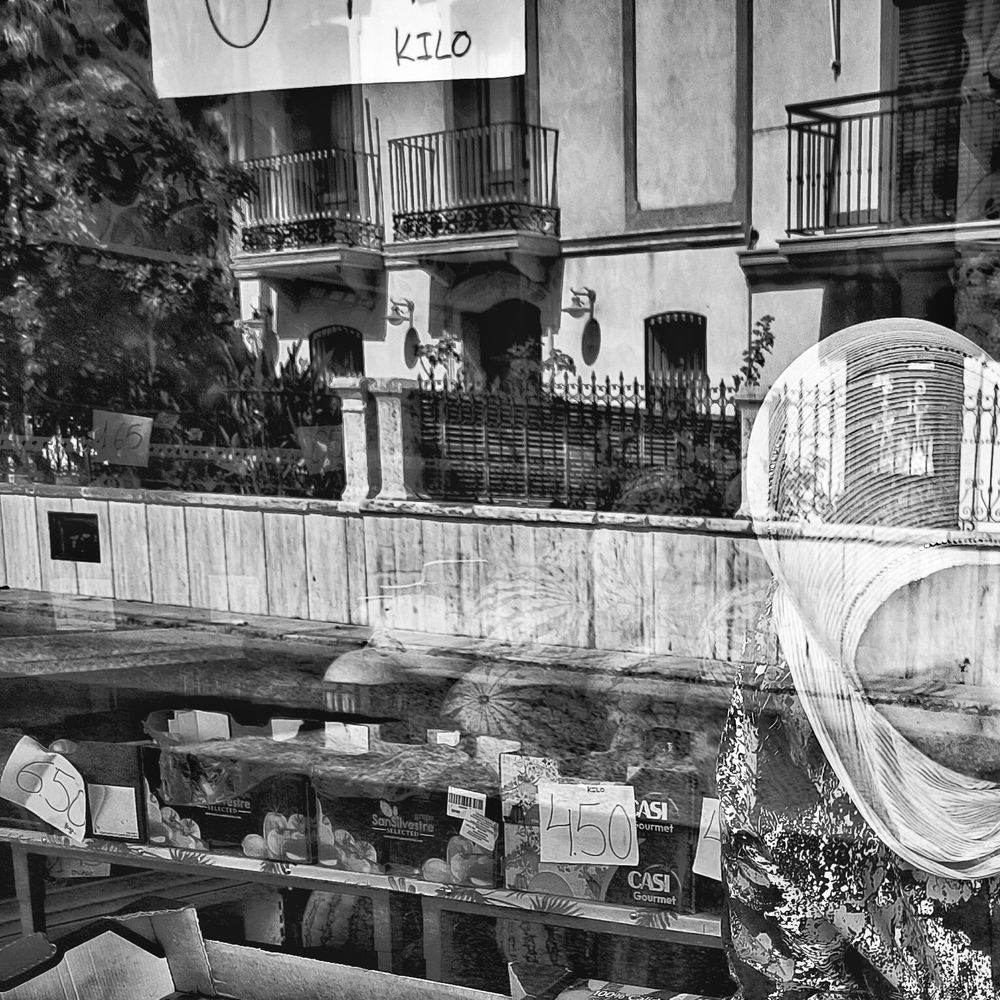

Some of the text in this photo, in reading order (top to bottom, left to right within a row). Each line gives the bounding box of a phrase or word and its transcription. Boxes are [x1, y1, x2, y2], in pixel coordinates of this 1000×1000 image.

[395, 27, 472, 66] KILO
[636, 822, 674, 834] ourmet
[628, 870, 671, 893] CASI
[633, 891, 677, 906] Gourmet
